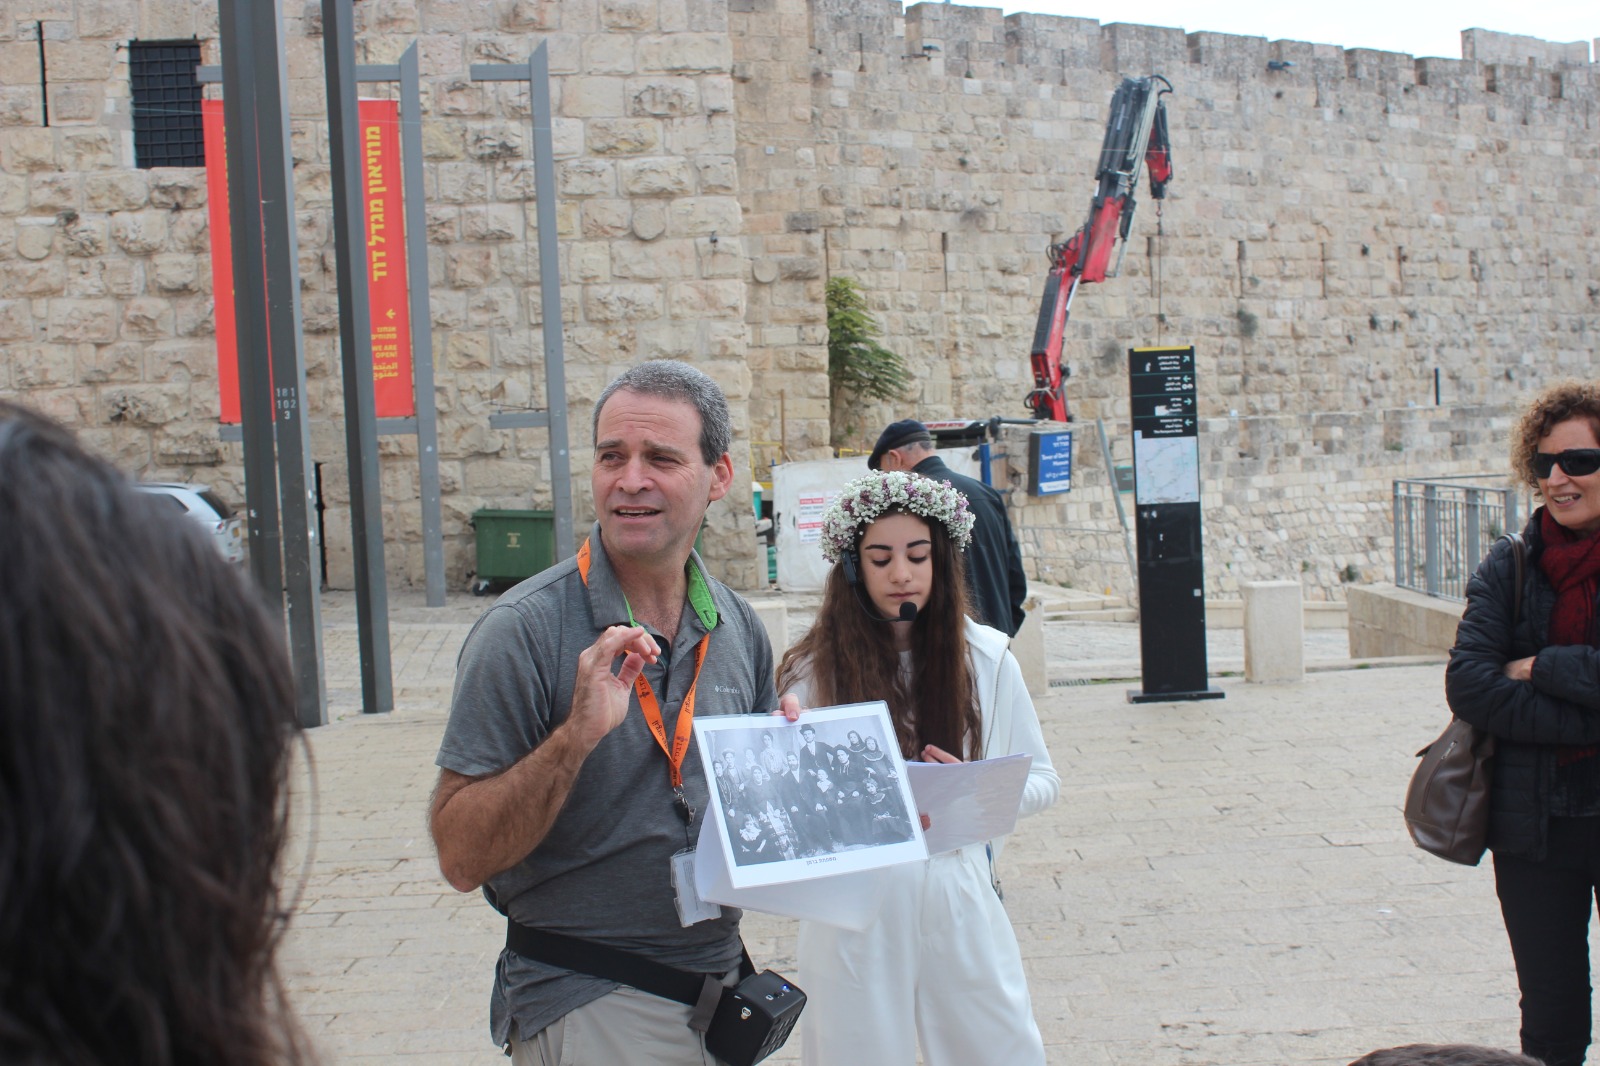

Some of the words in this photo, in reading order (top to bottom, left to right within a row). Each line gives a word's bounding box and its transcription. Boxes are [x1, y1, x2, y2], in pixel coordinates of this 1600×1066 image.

[366, 126, 387, 194] מוזיאון
[368, 199, 385, 247] מגדל
[372, 250, 387, 282] דוד
[277, 399, 296, 409] 102
[284, 410, 290, 420] 3
